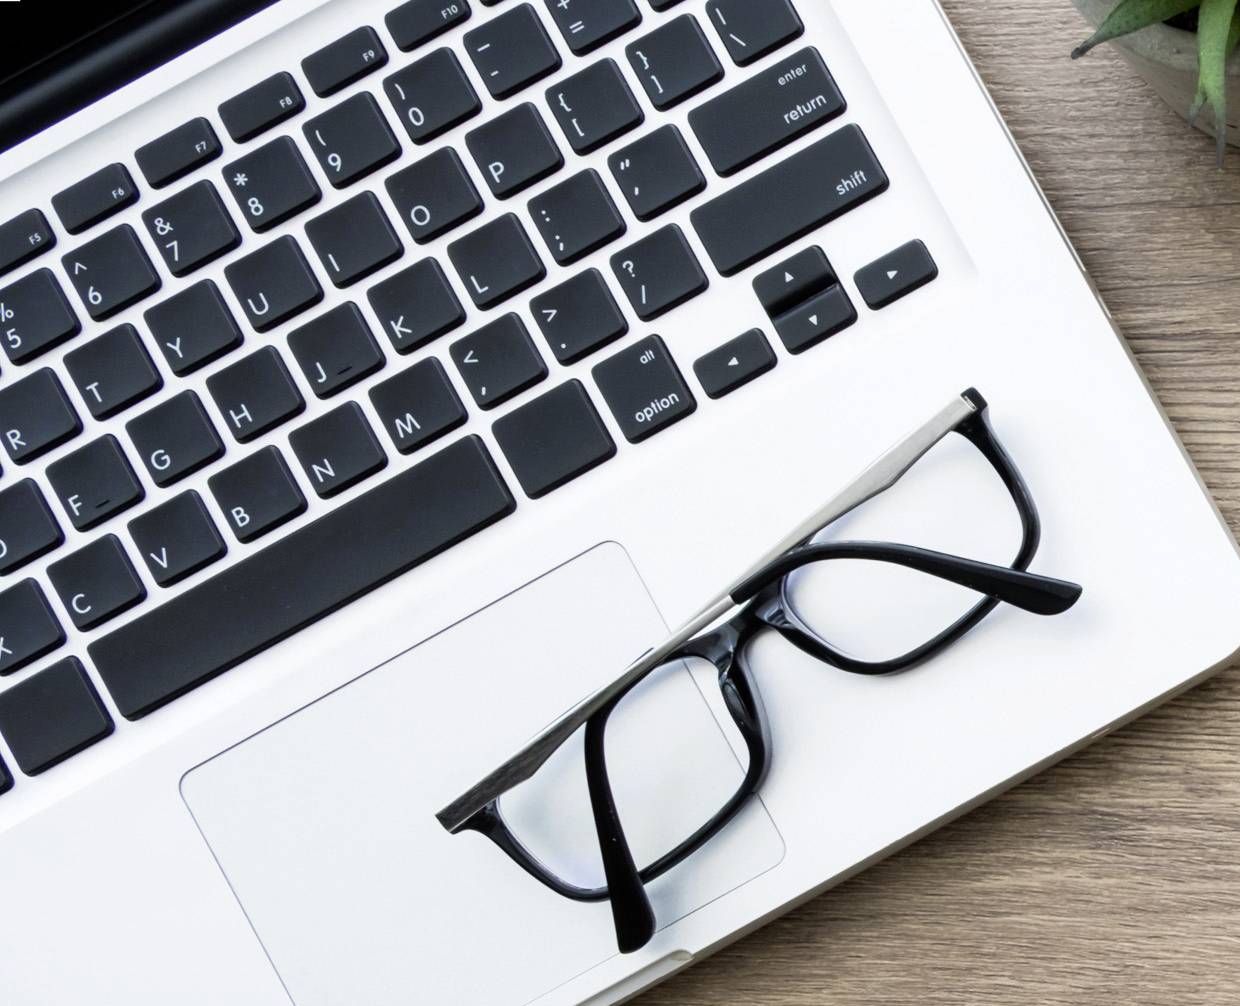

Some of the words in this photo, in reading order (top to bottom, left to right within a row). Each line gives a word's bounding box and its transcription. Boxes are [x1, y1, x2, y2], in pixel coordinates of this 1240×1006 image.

[440, 4, 459, 20] F10
[362, 49, 375, 62] F9
[777, 63, 808, 86] enter
[279, 96, 293, 109] F8
[783, 93, 828, 125] return
[195, 140, 208, 154] F7
[327, 152, 342, 173] 9
[487, 161, 505, 184] P
[111, 187, 125, 199] F6
[835, 169, 868, 196] shift
[247, 196, 265, 217] 8
[153, 217, 174, 236] &
[28, 232, 42, 245] F5
[165, 239, 180, 262] 7
[621, 260, 636, 278] ?
[87, 285, 103, 305] 6
[469, 275, 489, 294] L
[247, 292, 270, 316] U
[6, 327, 22, 349] 5
[389, 315, 413, 339] K
[165, 336, 184, 359] Y
[639, 349, 656, 365] alt
[315, 361, 328, 384] J
[85, 381, 103, 403] T
[229, 403, 253, 429] H
[634, 392, 680, 423] option
[394, 412, 422, 439] M
[5, 428, 27, 451] R
[150, 448, 172, 471] G
[311, 458, 336, 483] N
[67, 494, 83, 517] F
[230, 506, 251, 528] B
[149, 546, 168, 569] V
[71, 593, 92, 615] C
